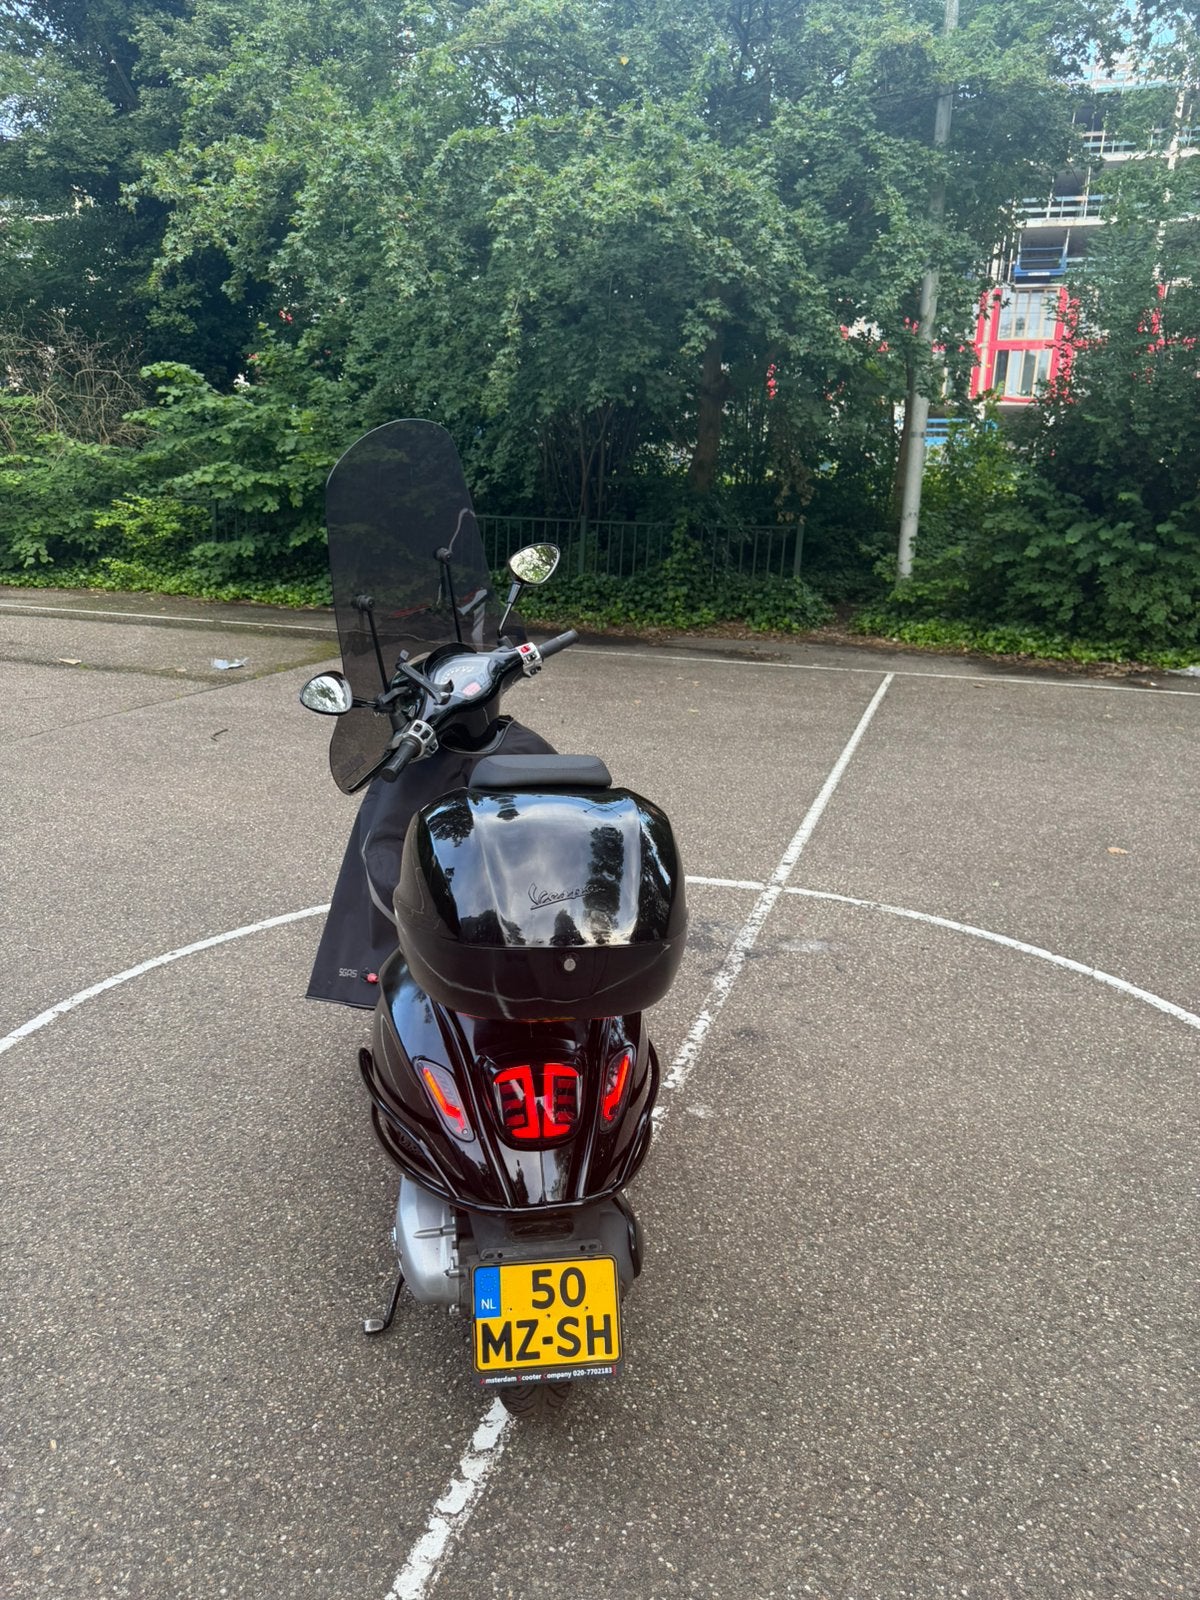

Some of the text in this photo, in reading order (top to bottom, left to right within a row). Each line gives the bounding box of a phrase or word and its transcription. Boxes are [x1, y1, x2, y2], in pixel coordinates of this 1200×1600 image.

[531, 1266, 587, 1310] 50
[480, 1298, 497, 1310] NL
[480, 1313, 614, 1364] MZ-SH
[480, 1375, 517, 1386] Amsterdam
[542, 1371, 572, 1382] Company
